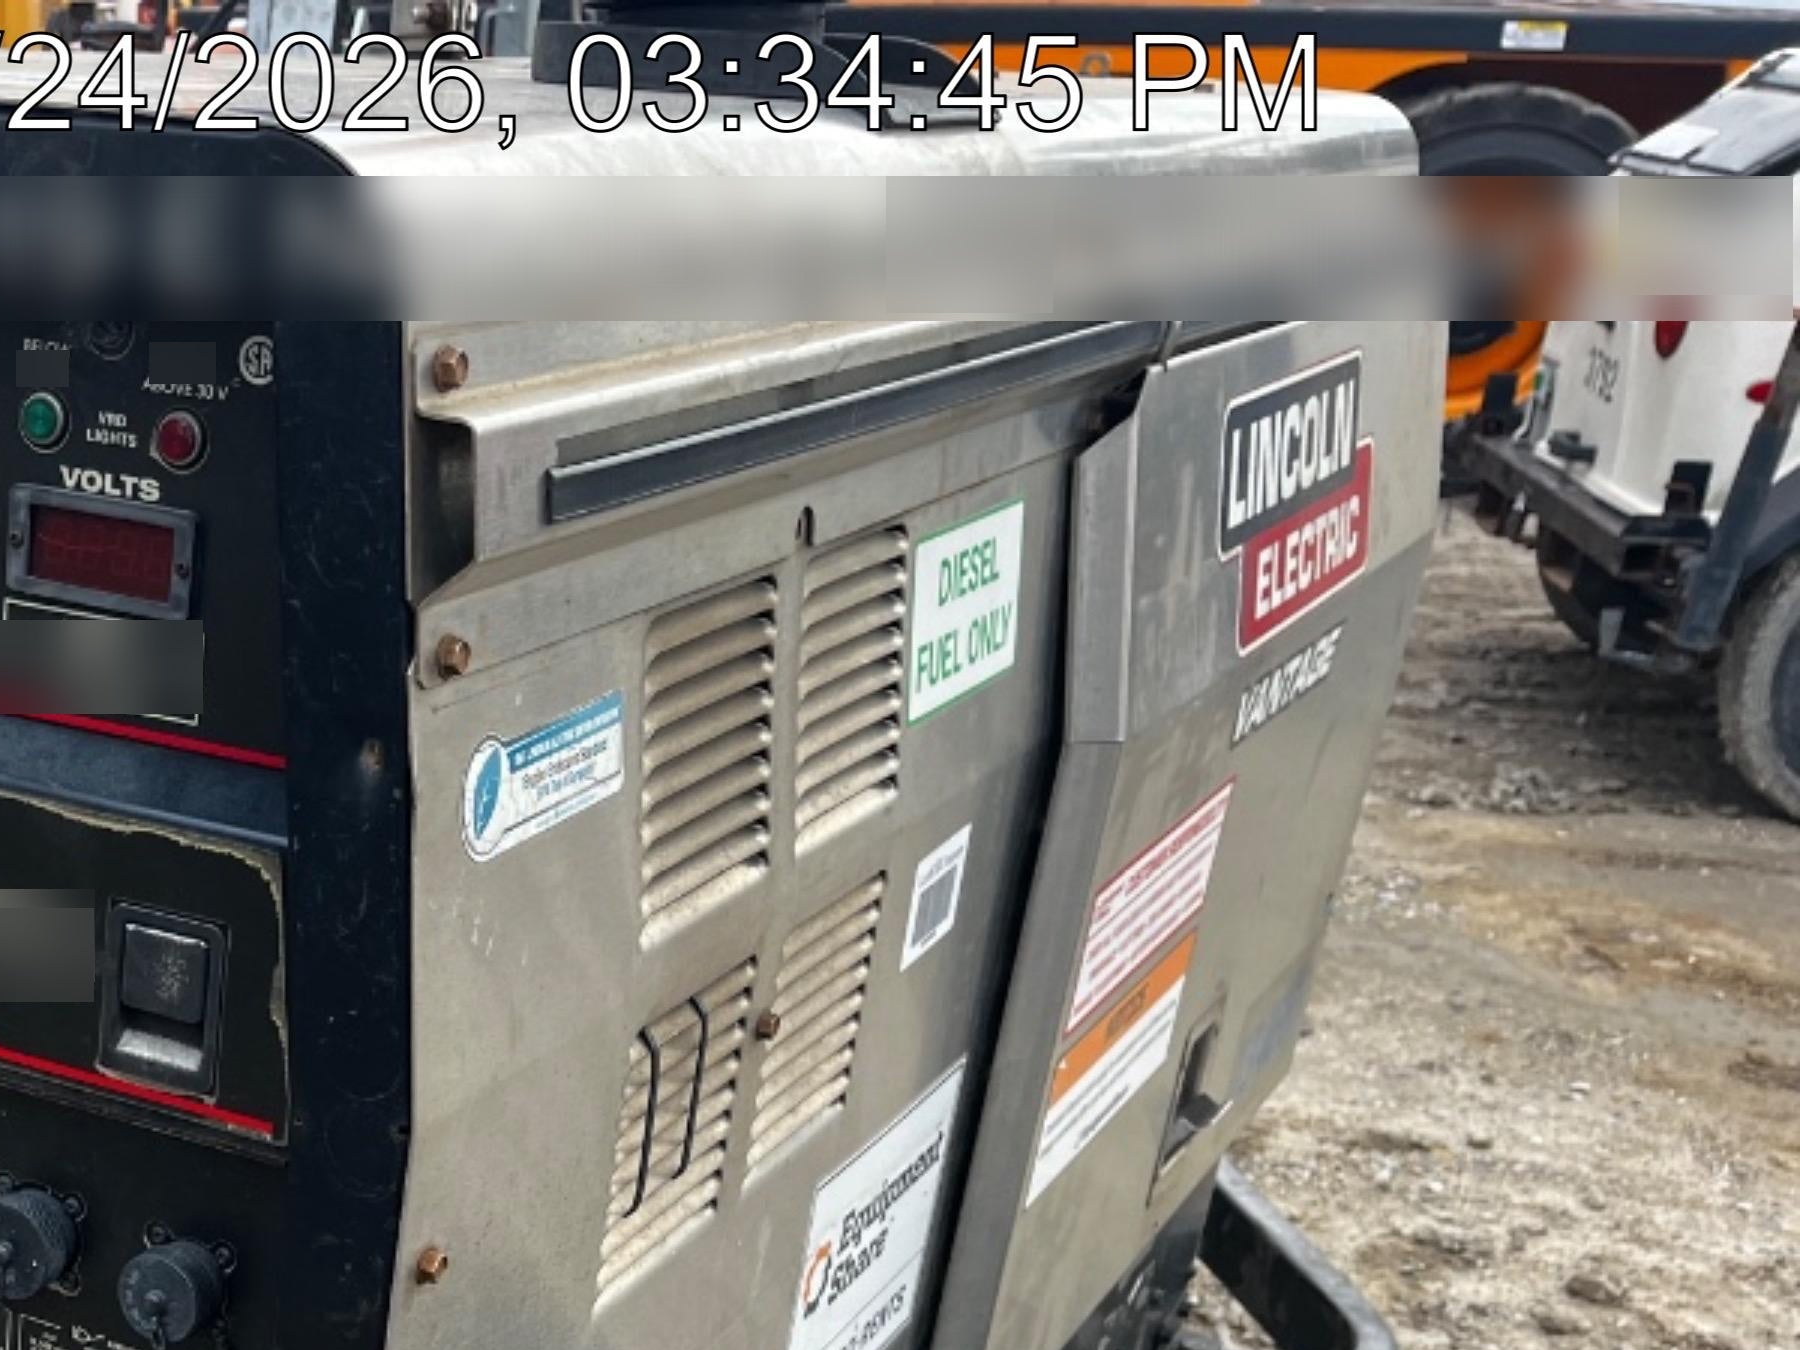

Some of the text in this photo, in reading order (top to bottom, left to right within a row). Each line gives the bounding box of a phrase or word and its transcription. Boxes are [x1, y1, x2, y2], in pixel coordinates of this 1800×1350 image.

[85, 428, 139, 449] LIGHTS
[1226, 378, 1356, 530] LINCOLN
[58, 464, 161, 502] VOLTS
[938, 536, 1000, 607] DIESEL
[1253, 494, 1361, 622] ELECTRIC
[914, 600, 1014, 694] FUEL ONLY
[835, 1130, 945, 1257] Equipment
[826, 1228, 889, 1306] Share
